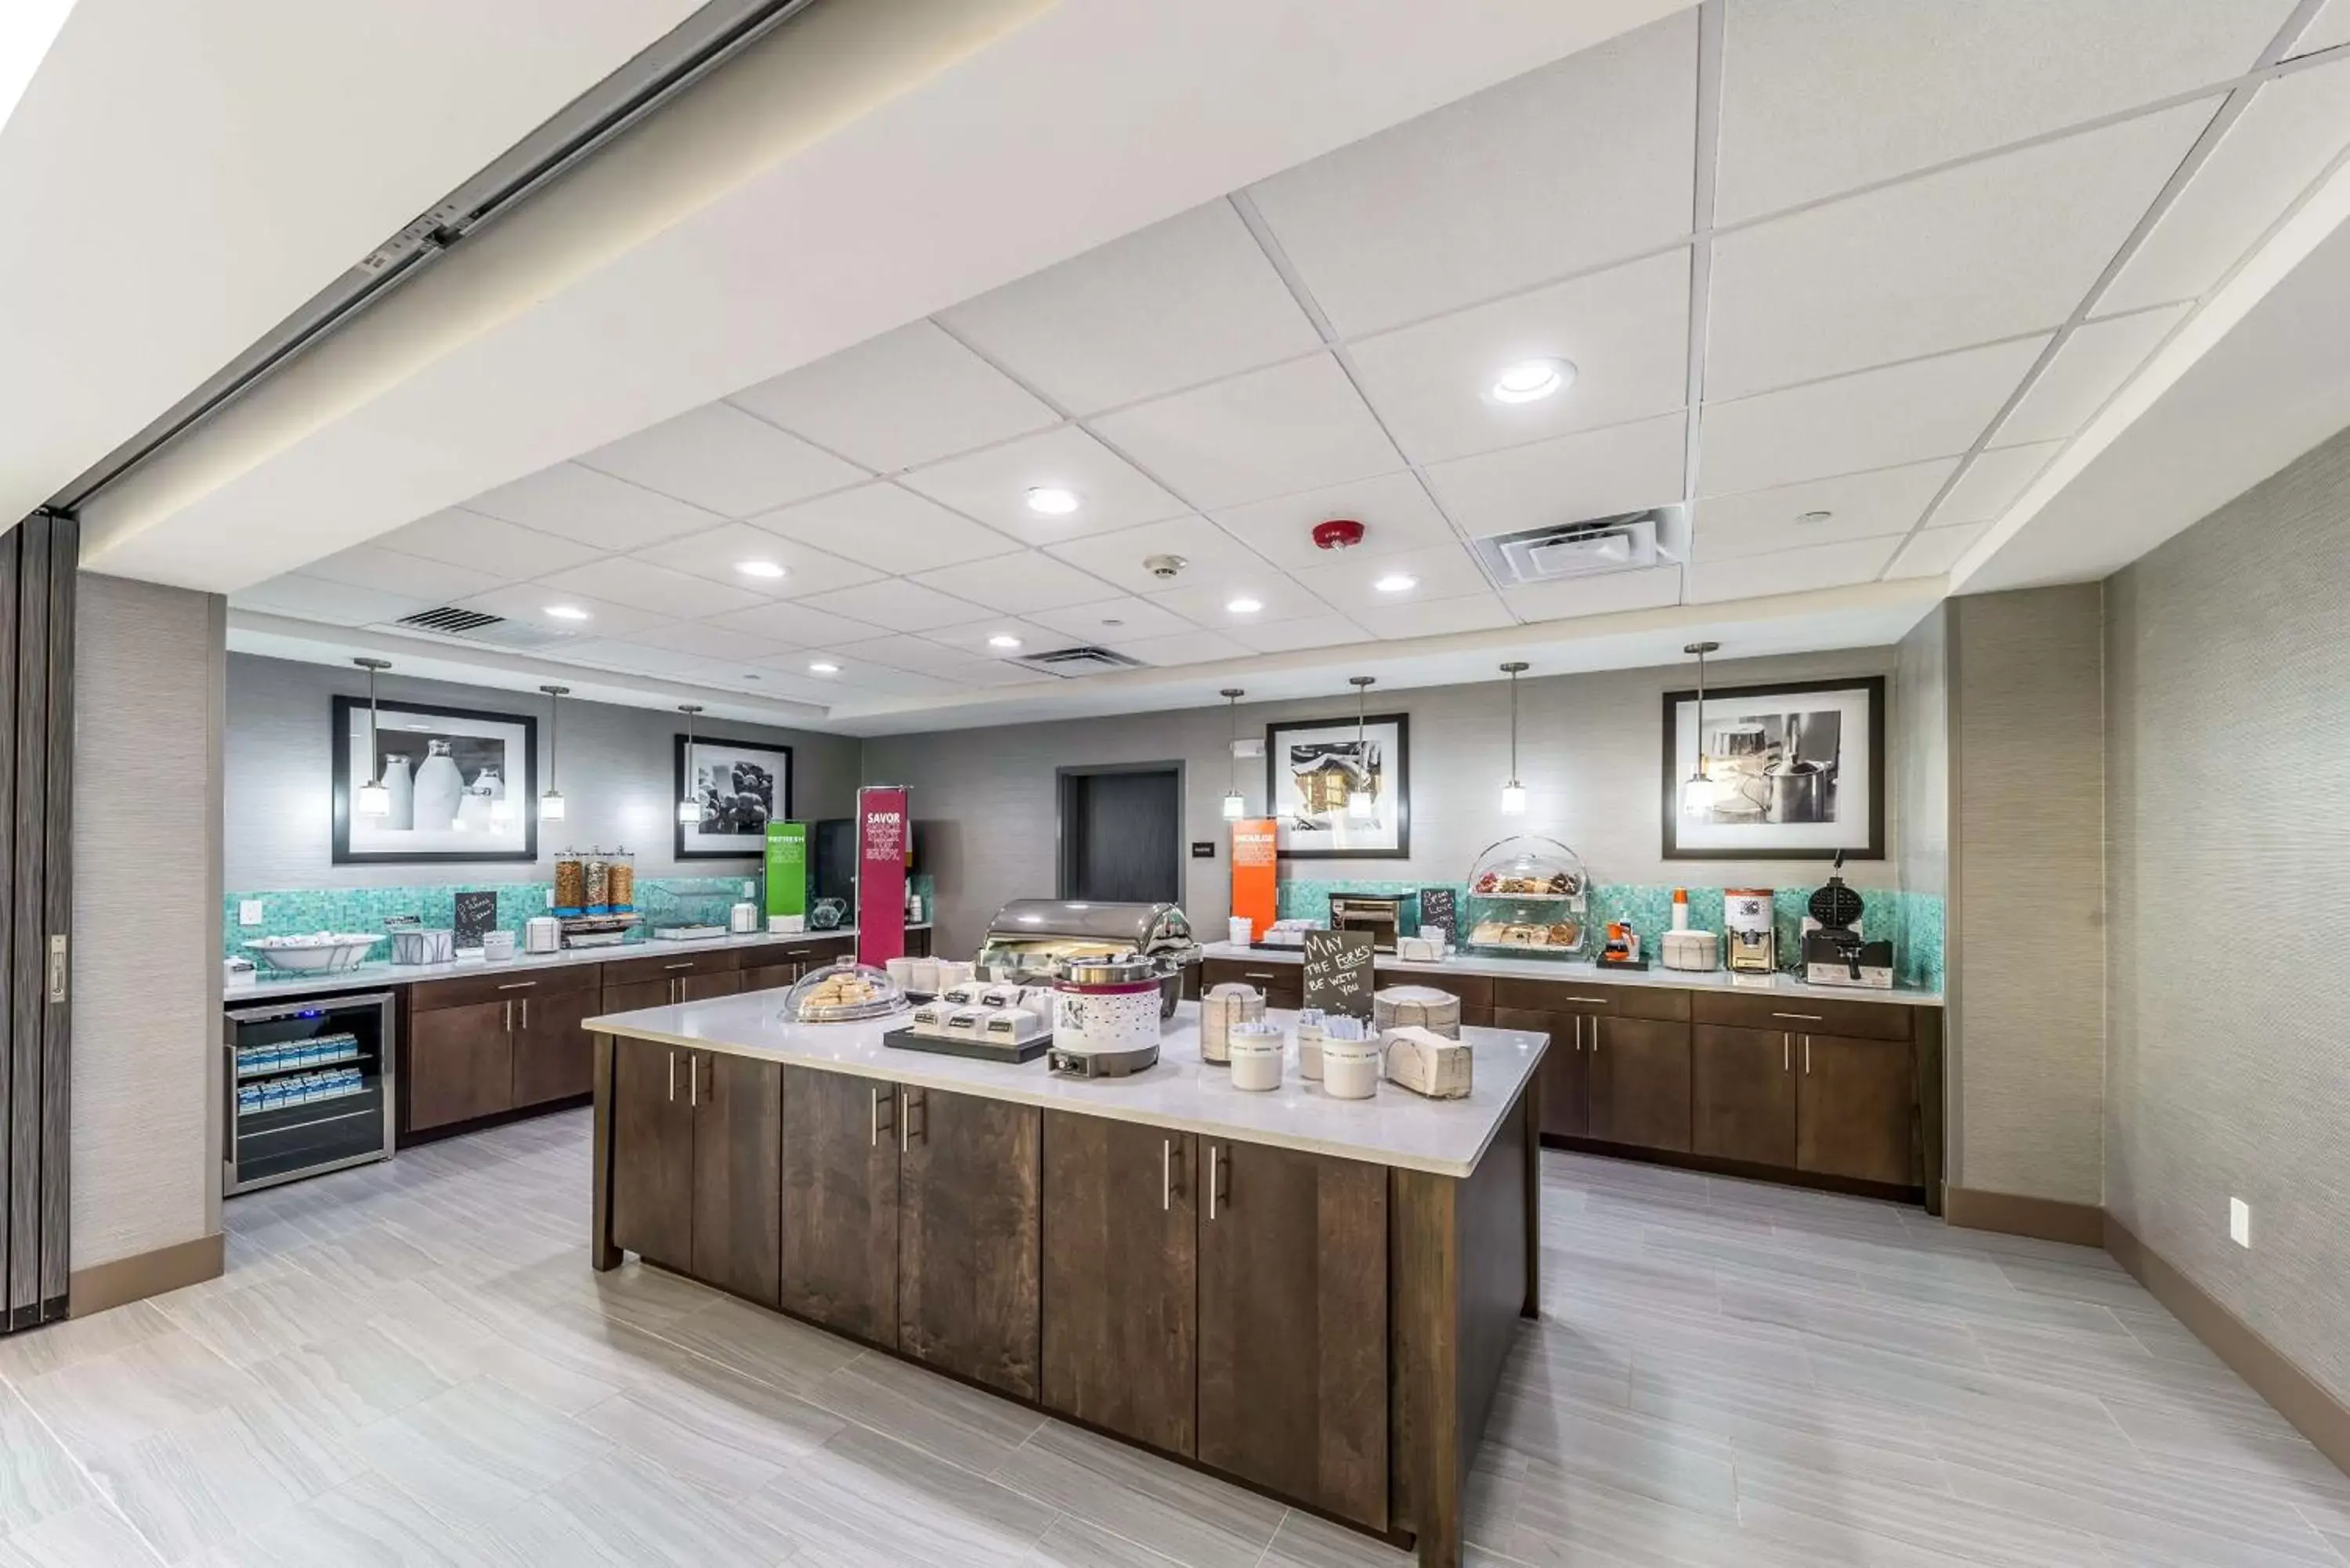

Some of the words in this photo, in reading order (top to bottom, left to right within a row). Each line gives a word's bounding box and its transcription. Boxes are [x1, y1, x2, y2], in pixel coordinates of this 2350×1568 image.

[867, 812, 901, 824] SAVOR
[1306, 935, 1343, 960] MAY
[1303, 960, 1331, 975] THE
[1334, 945, 1370, 969] FORKS
[1309, 977, 1325, 991] BE
[1328, 970, 1358, 986] WITH
[1339, 983, 1361, 996] YOU
